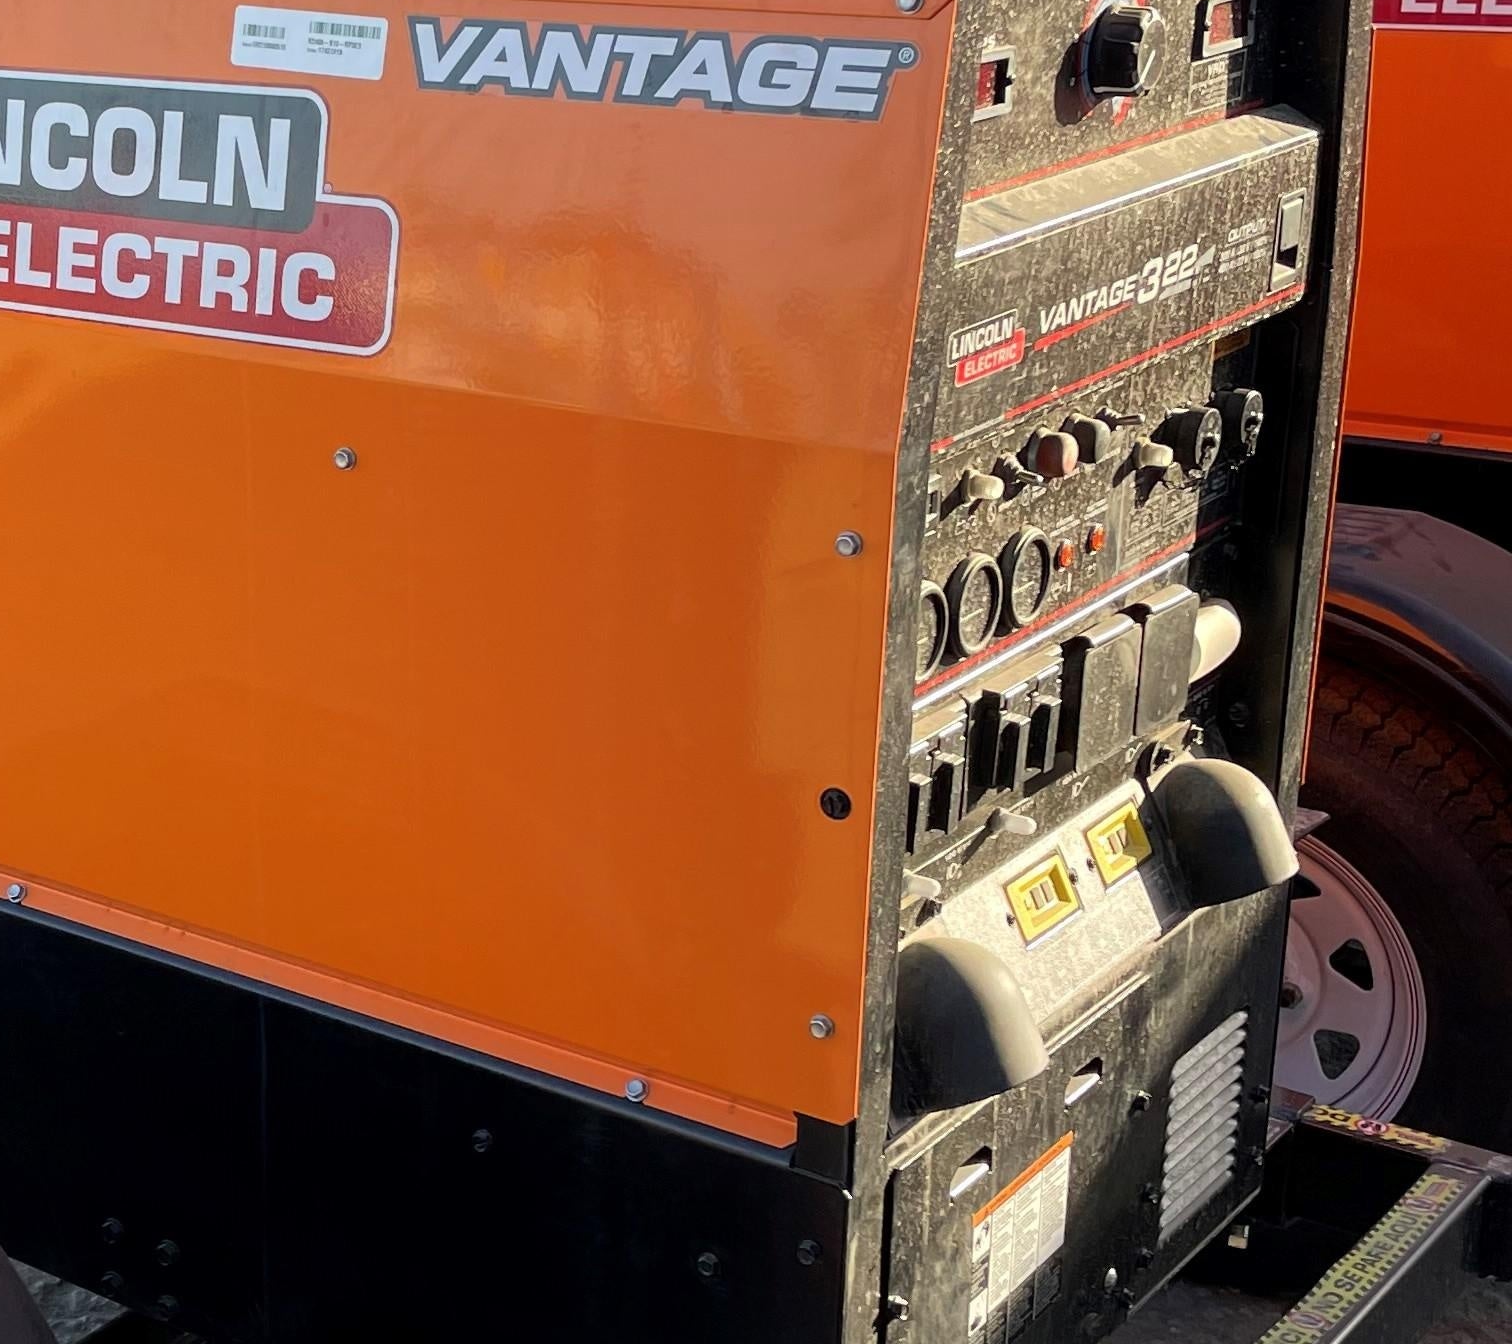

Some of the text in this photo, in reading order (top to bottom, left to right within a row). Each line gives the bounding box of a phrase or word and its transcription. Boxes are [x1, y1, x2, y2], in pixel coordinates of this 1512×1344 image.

[413, 22, 892, 114] VANTAGE
[1040, 274, 1139, 334] VANTAGE
[1138, 243, 1199, 305] 322
[951, 316, 1014, 360] LINCOLN
[963, 343, 1017, 378] ELECTRIC
[1313, 1290, 1345, 1315] NO
[1334, 1267, 1365, 1293] SE
[1354, 1240, 1393, 1274] PARE
[1388, 1212, 1421, 1244] AQUI
